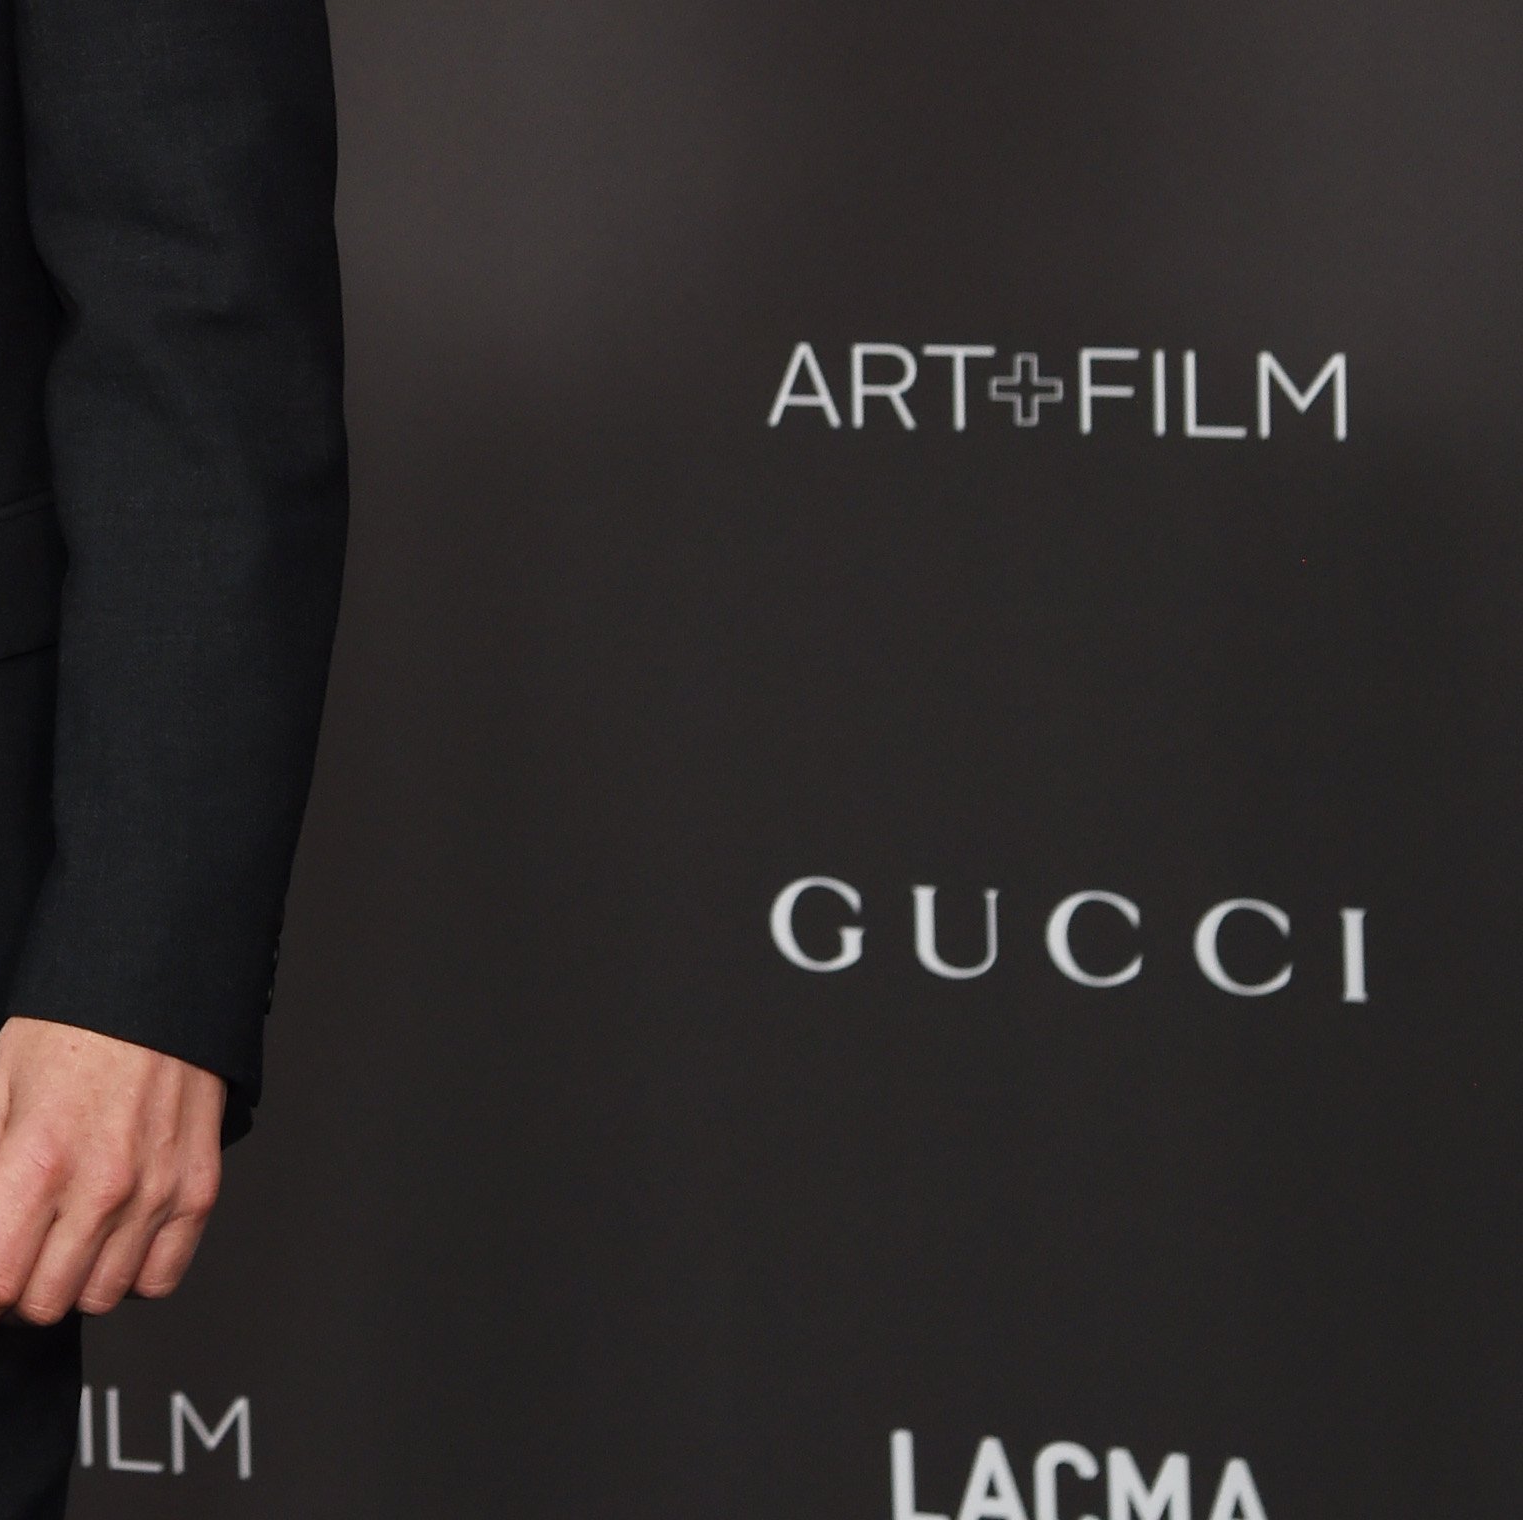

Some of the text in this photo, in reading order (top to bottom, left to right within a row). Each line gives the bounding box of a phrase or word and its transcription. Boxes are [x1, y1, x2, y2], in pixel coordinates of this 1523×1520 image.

[767, 341, 1348, 442] ART+FILM
[769, 875, 1368, 1003] GUCCI
[890, 1428, 1268, 1520] LACMA
